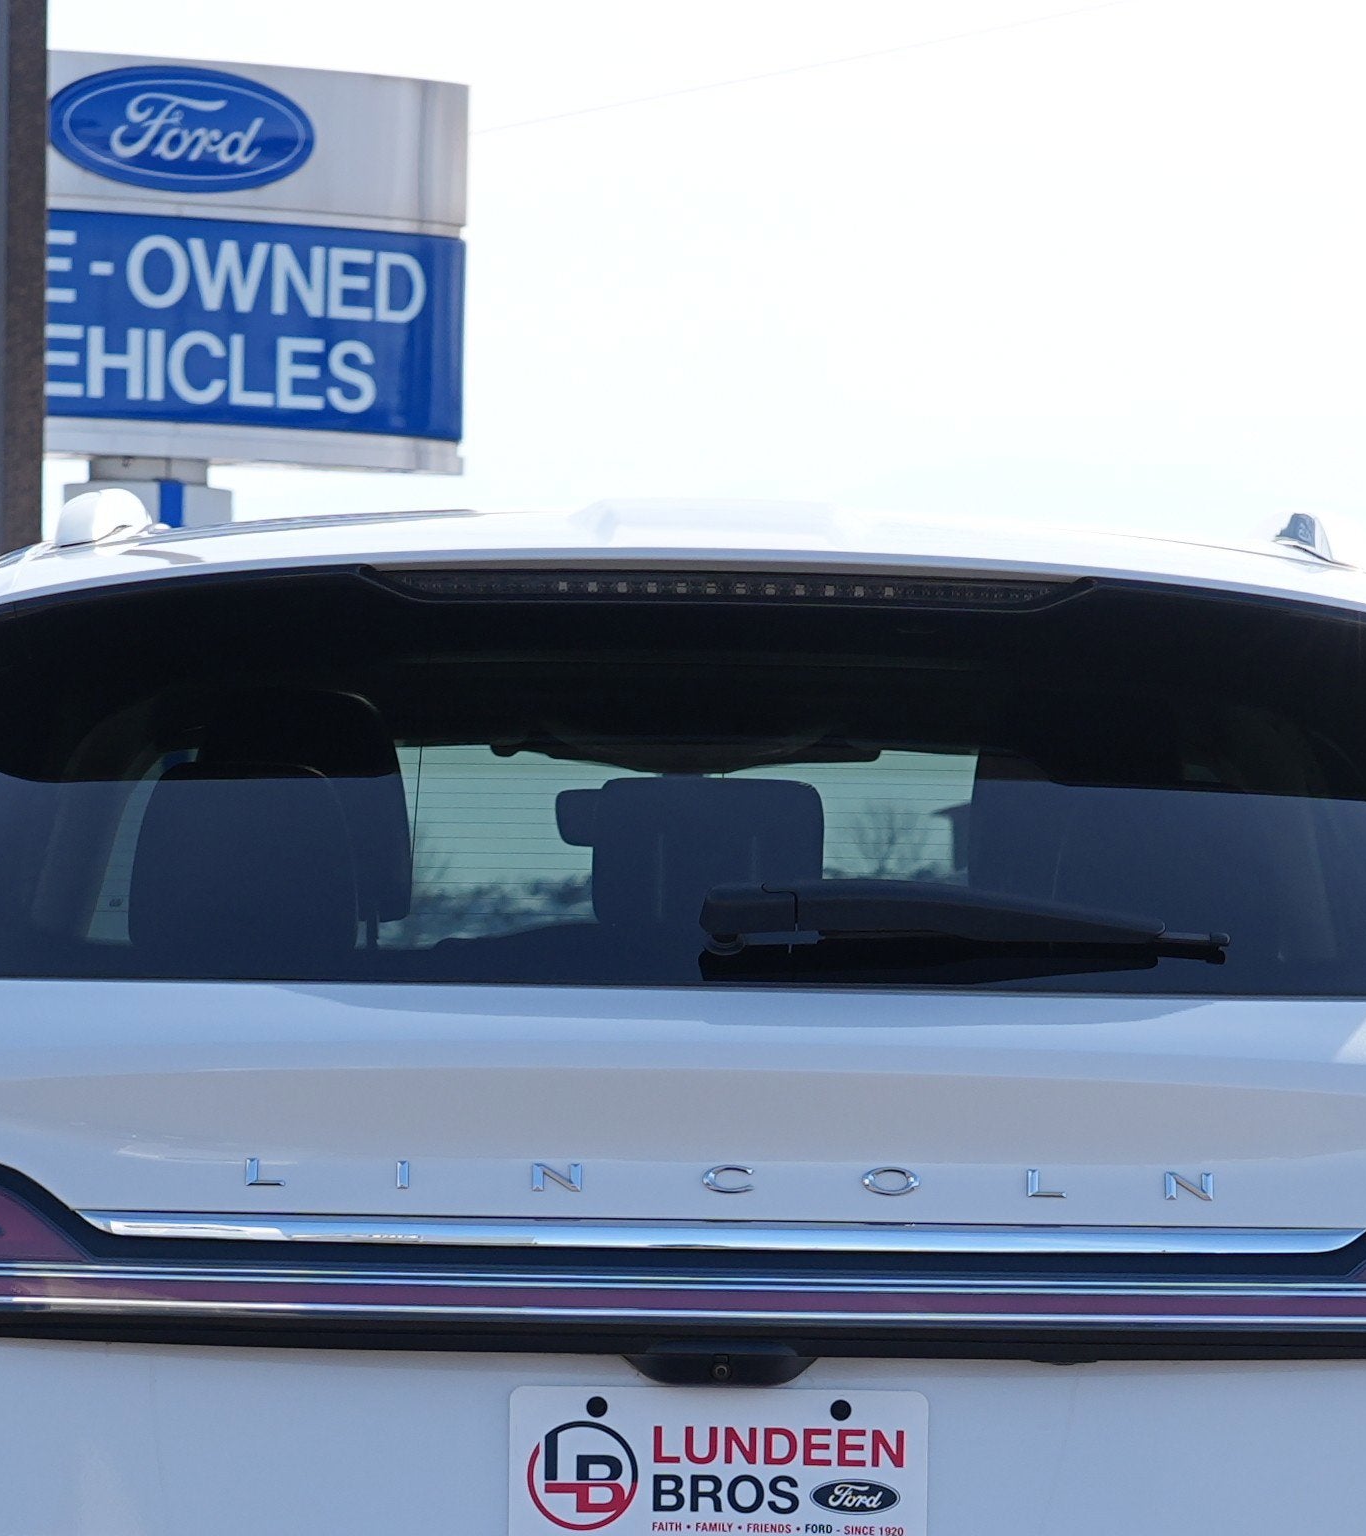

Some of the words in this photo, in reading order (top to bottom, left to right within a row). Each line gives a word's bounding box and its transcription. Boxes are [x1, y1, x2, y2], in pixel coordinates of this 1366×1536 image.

[109, 92, 263, 165] Ford
[245, 1157, 1213, 1202] LINCOLN
[653, 1425, 905, 1468] LUNDEEN
[652, 1473, 800, 1515] BROS
[828, 1483, 883, 1508] Ford
[652, 1522, 682, 1532] FAITH
[695, 1522, 733, 1533] FAMILY
[747, 1523, 792, 1534] FRIENDS
[805, 1524, 833, 1534] FORD
[844, 1525, 875, 1536] SINCE
[879, 1526, 904, 1536] 1920
